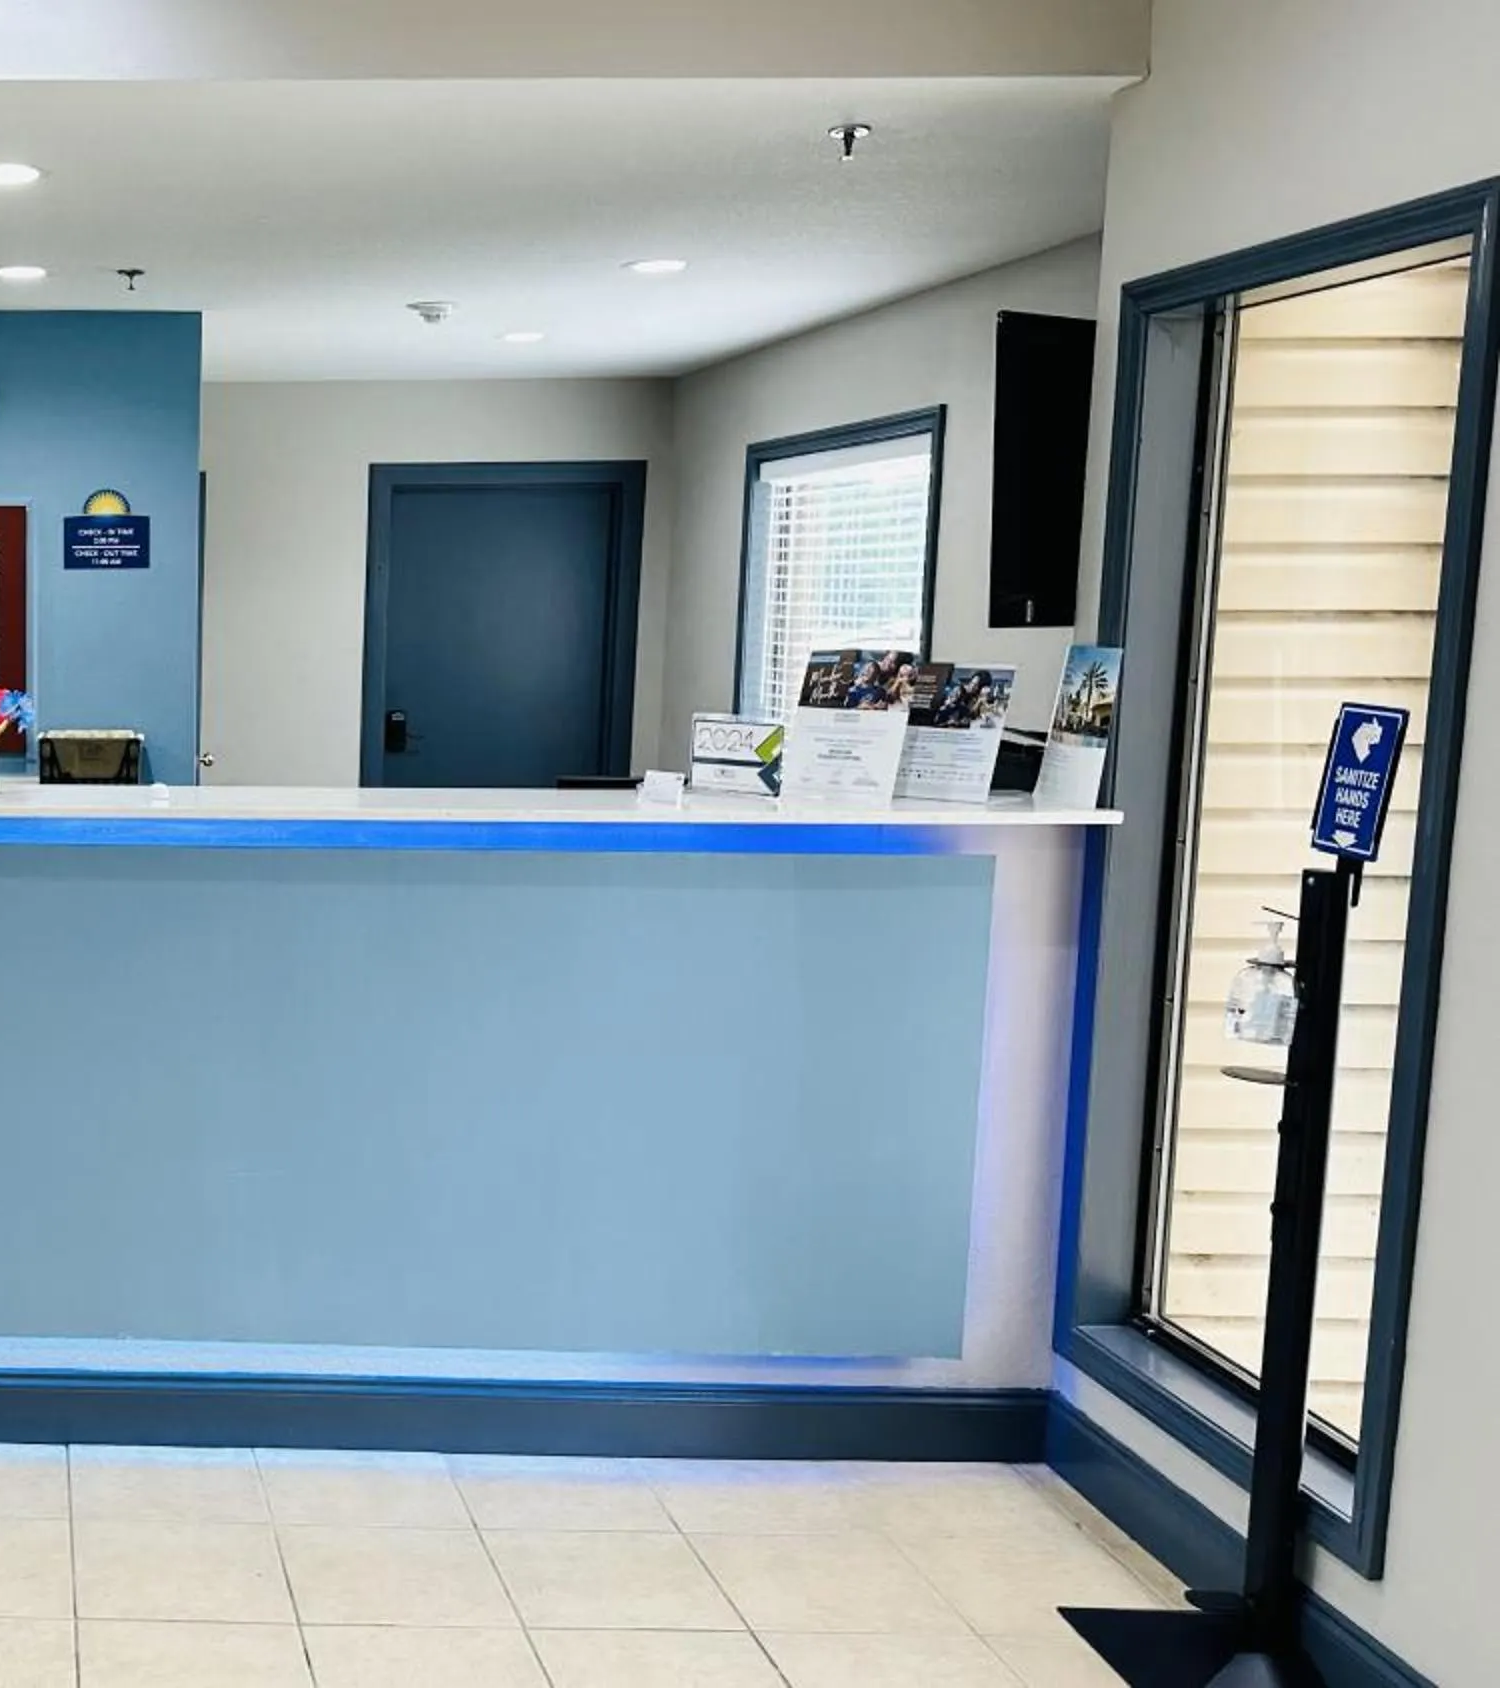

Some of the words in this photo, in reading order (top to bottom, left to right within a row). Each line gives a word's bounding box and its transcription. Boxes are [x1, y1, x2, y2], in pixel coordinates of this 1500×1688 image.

[74, 549, 99, 557] CHECK
[697, 727, 755, 752] 2024
[1335, 765, 1380, 791] SANITIZE
[1335, 787, 1371, 809] HANDS
[1335, 807, 1362, 829] HERE
